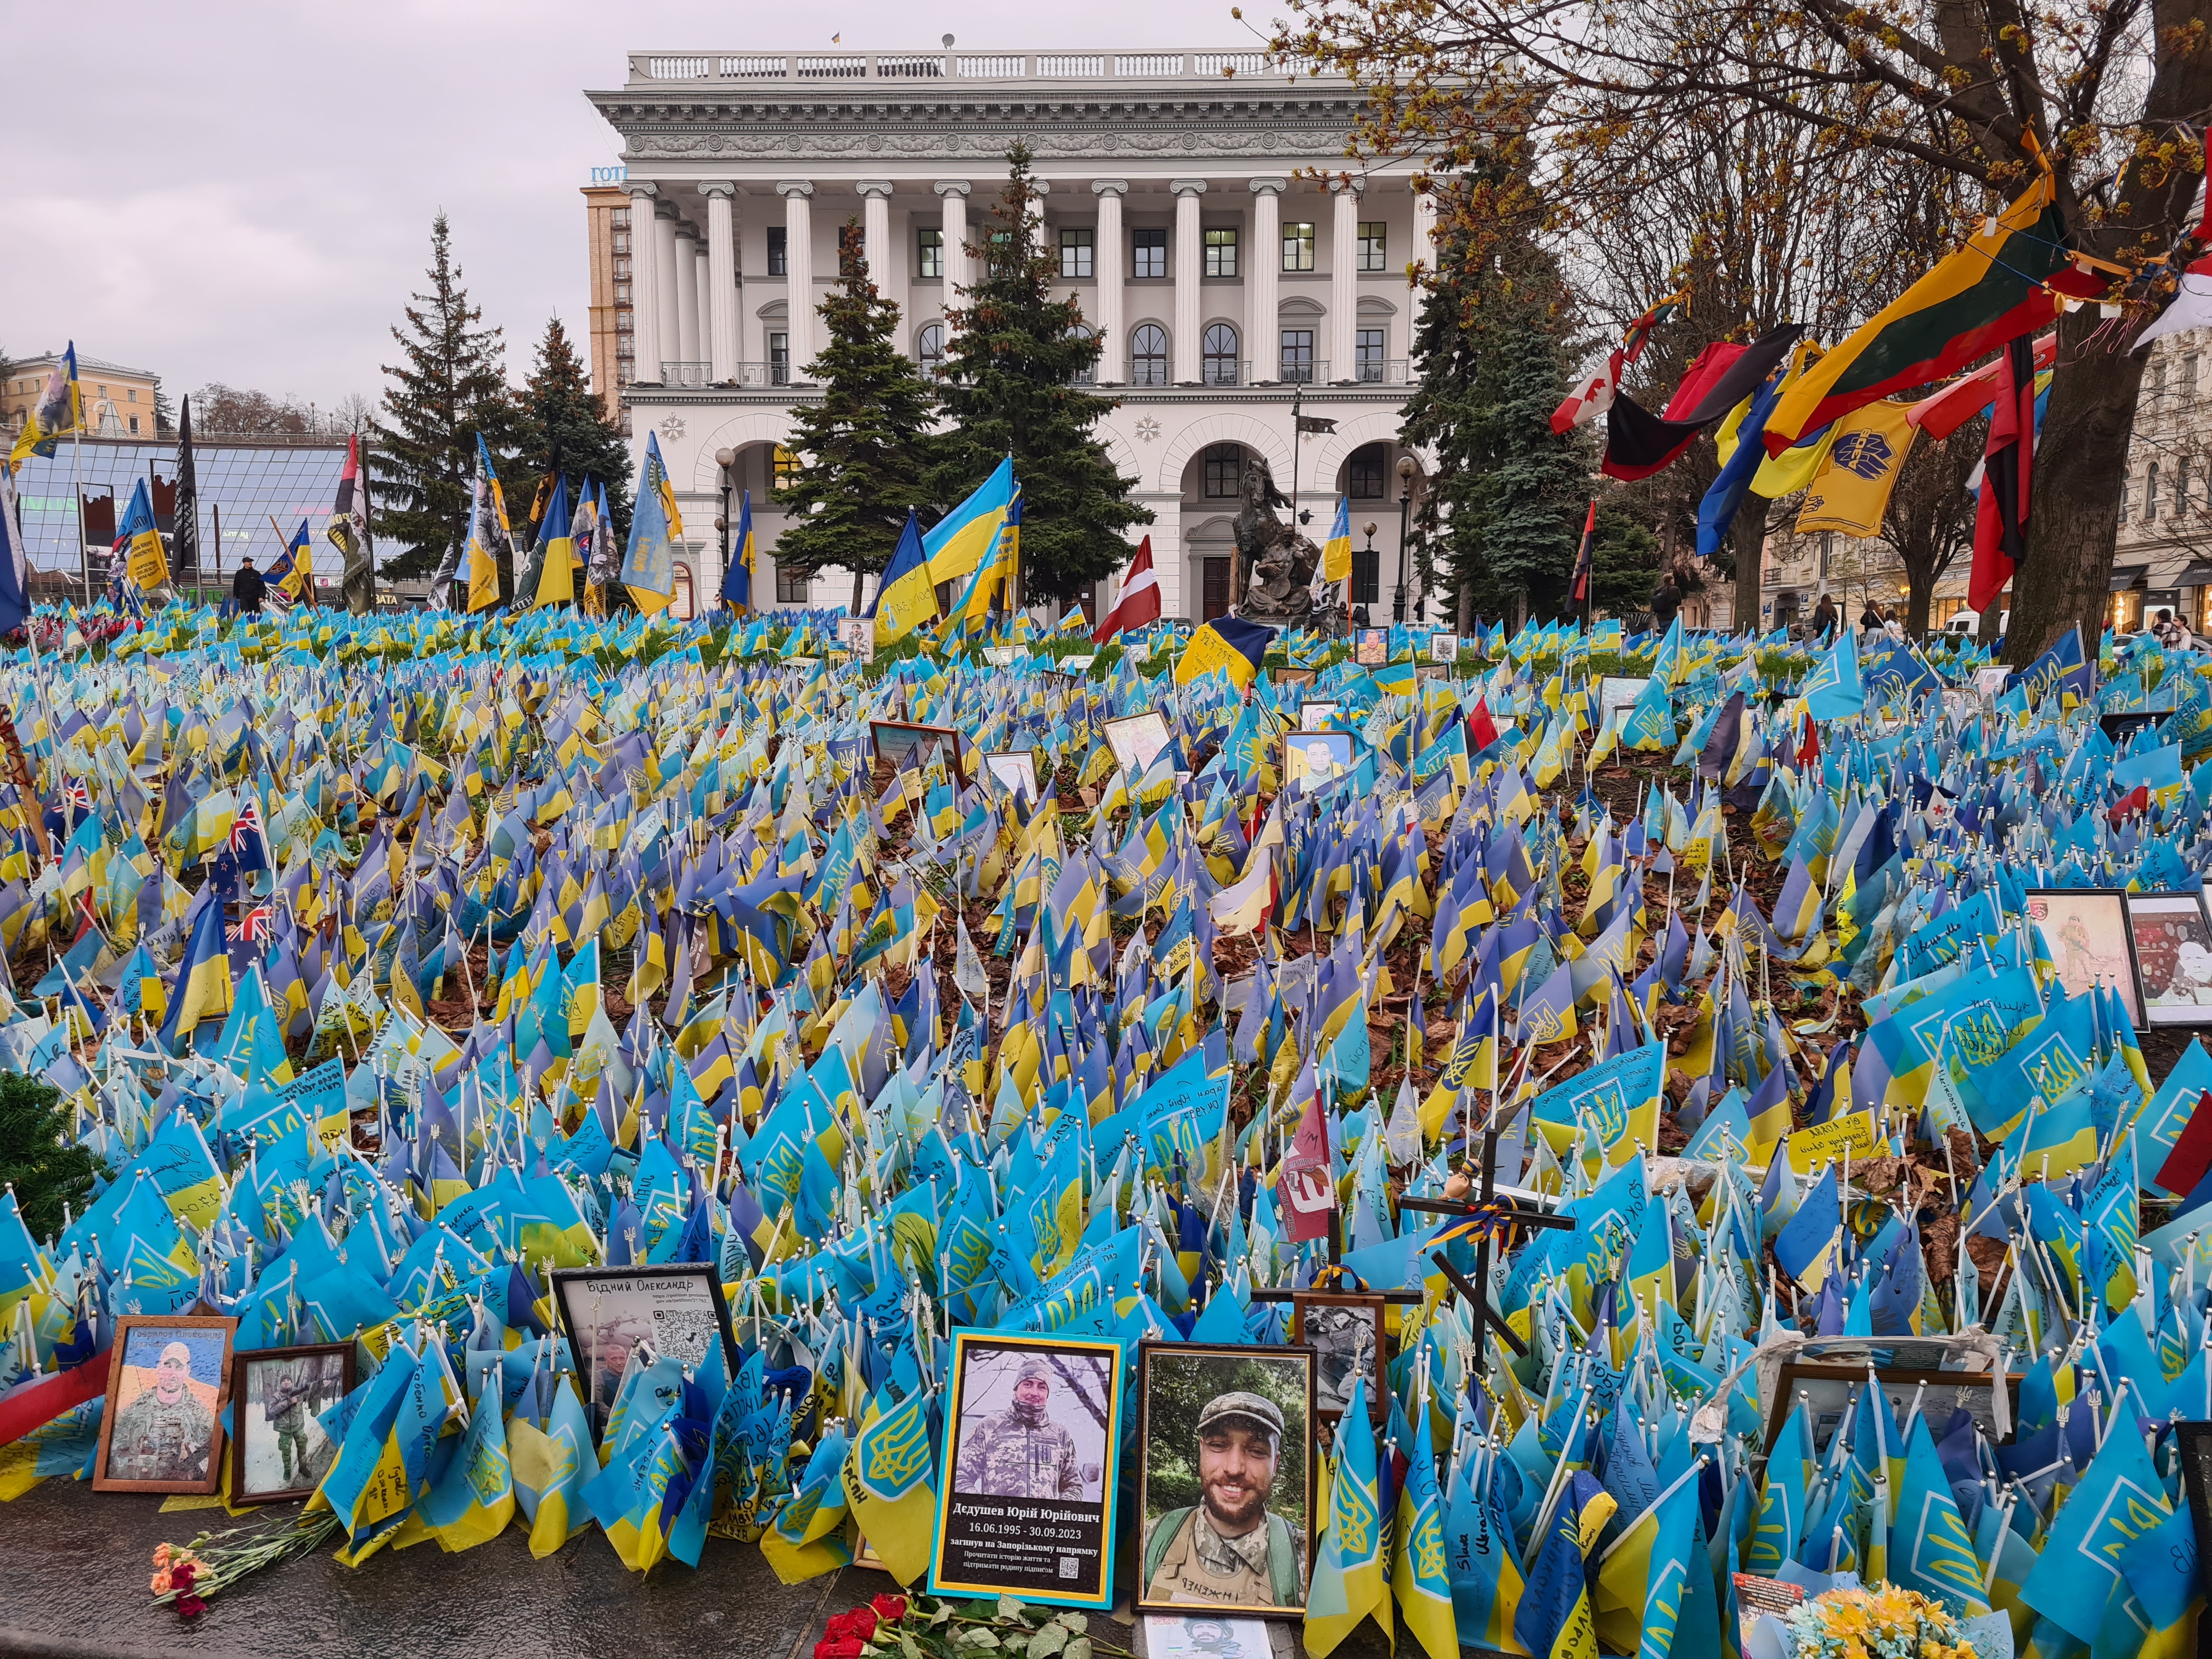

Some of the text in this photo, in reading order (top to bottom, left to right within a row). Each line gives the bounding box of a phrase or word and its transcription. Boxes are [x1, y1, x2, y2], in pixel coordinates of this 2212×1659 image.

[1007, 1506, 1038, 1519] Юрій
[1040, 1509, 1101, 1523] Юрійович
[969, 1522, 1021, 1536] 16.06.1995
[1029, 1526, 1081, 1539] 30.09.2023
[950, 1538, 983, 1548] загинув
[997, 1541, 1055, 1554] Запорізькому
[1056, 1546, 1098, 1557] напрямку
[964, 1550, 998, 1560] Прочитати
[999, 1553, 1021, 1562] історію
[963, 1561, 1053, 1574] підтримати родину підписом
